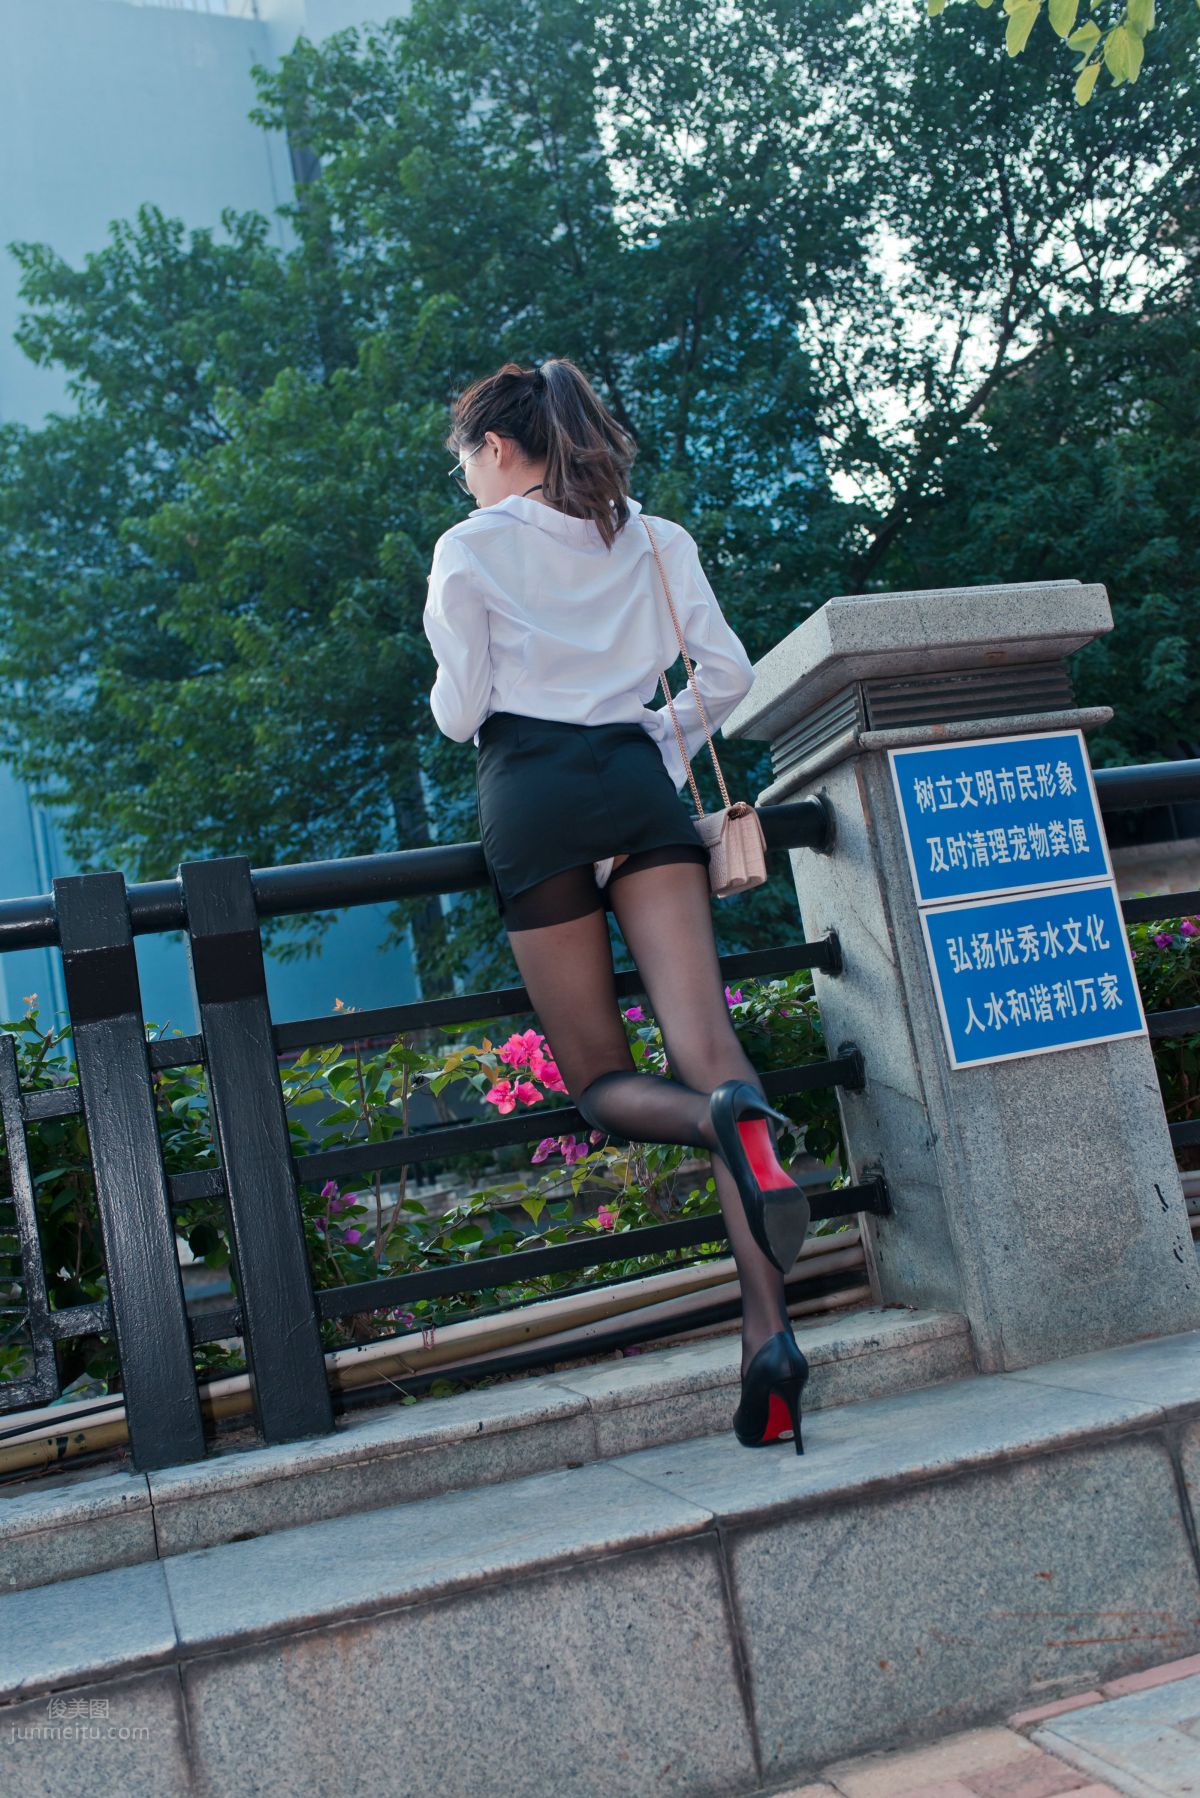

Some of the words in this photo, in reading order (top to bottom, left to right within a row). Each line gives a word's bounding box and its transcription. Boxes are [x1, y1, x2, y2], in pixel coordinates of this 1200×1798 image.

[914, 760, 1077, 813] 树立文明市民形象
[926, 818, 1089, 873] 及时清理宠物粪便
[946, 914, 1110, 974] 弘扬优秀水文化
[964, 972, 1123, 1036] 人水和谐利万家
